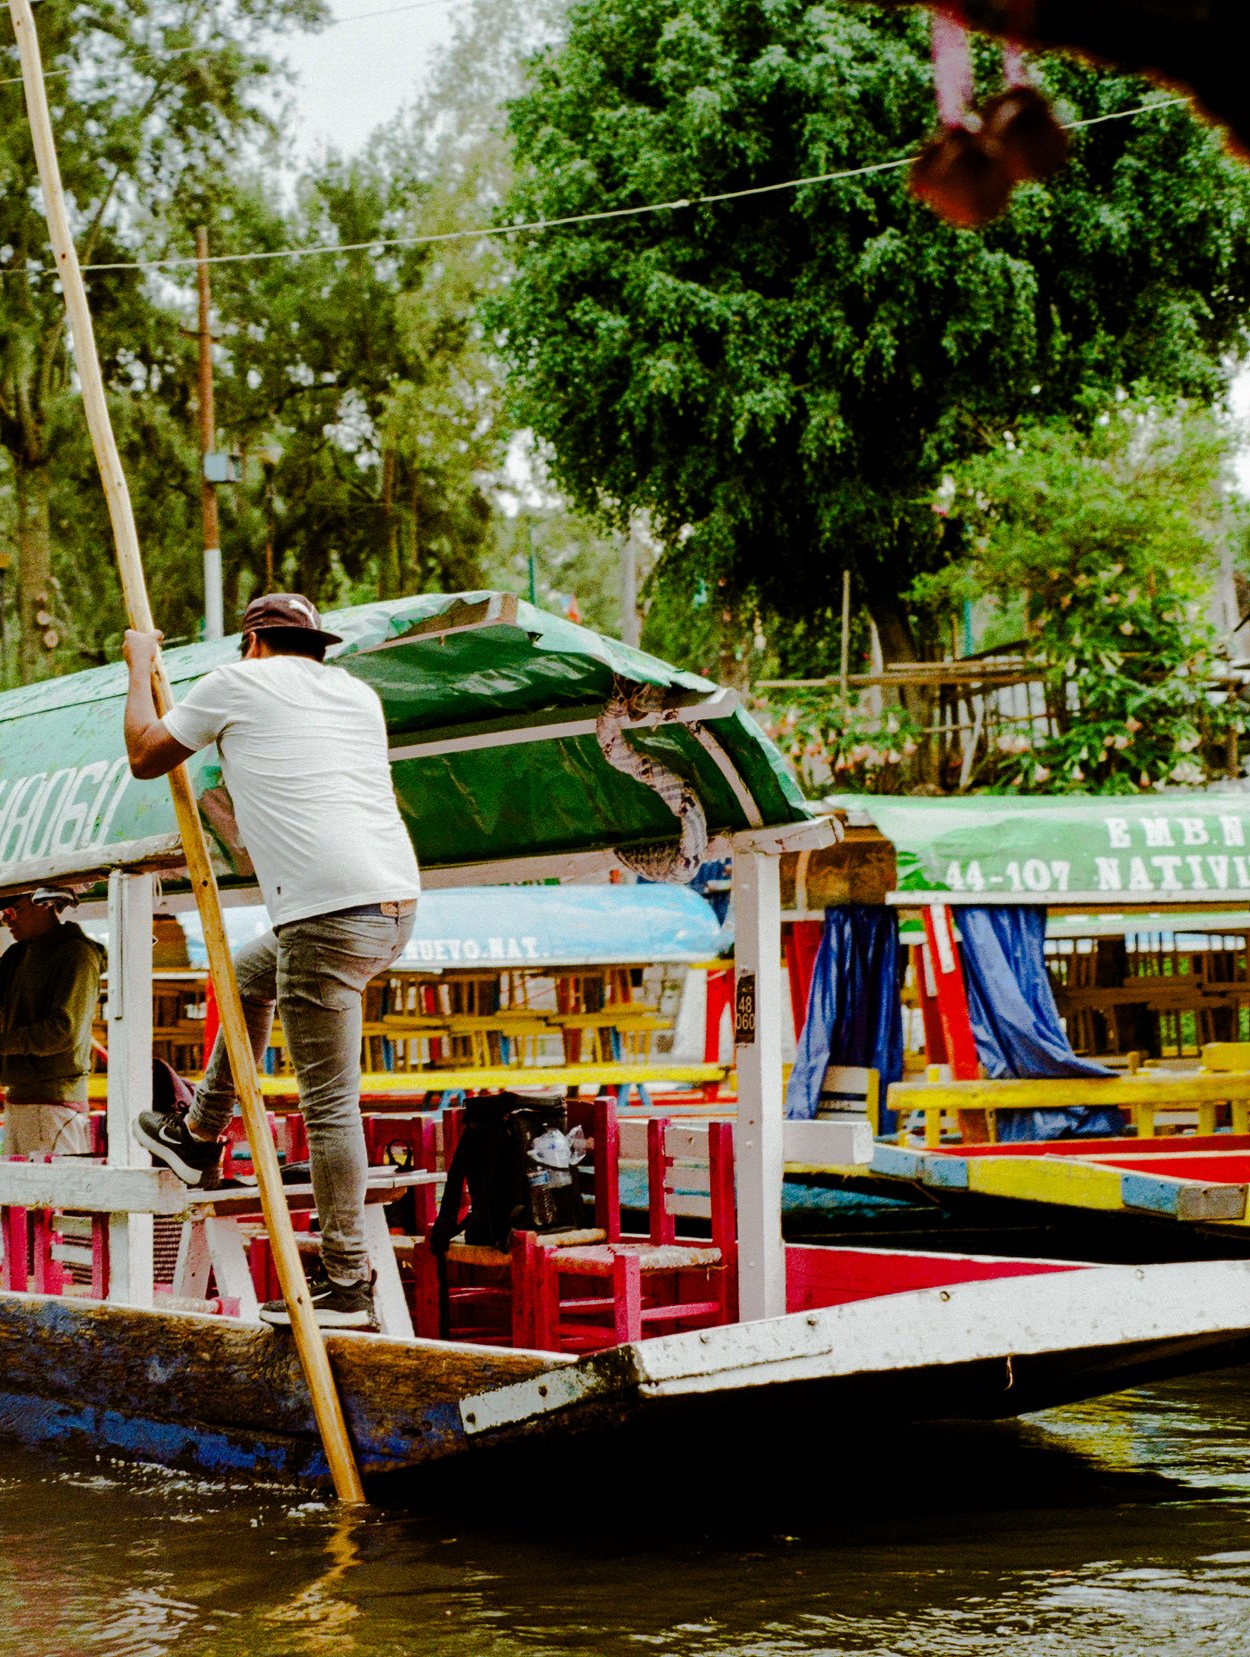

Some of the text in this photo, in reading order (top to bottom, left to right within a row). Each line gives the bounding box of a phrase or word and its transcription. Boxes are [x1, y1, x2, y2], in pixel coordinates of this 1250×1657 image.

[945, 855, 1250, 892] 44-107 NATIVI
[738, 996, 752, 1013] 48
[736, 1013, 755, 1030] 060
